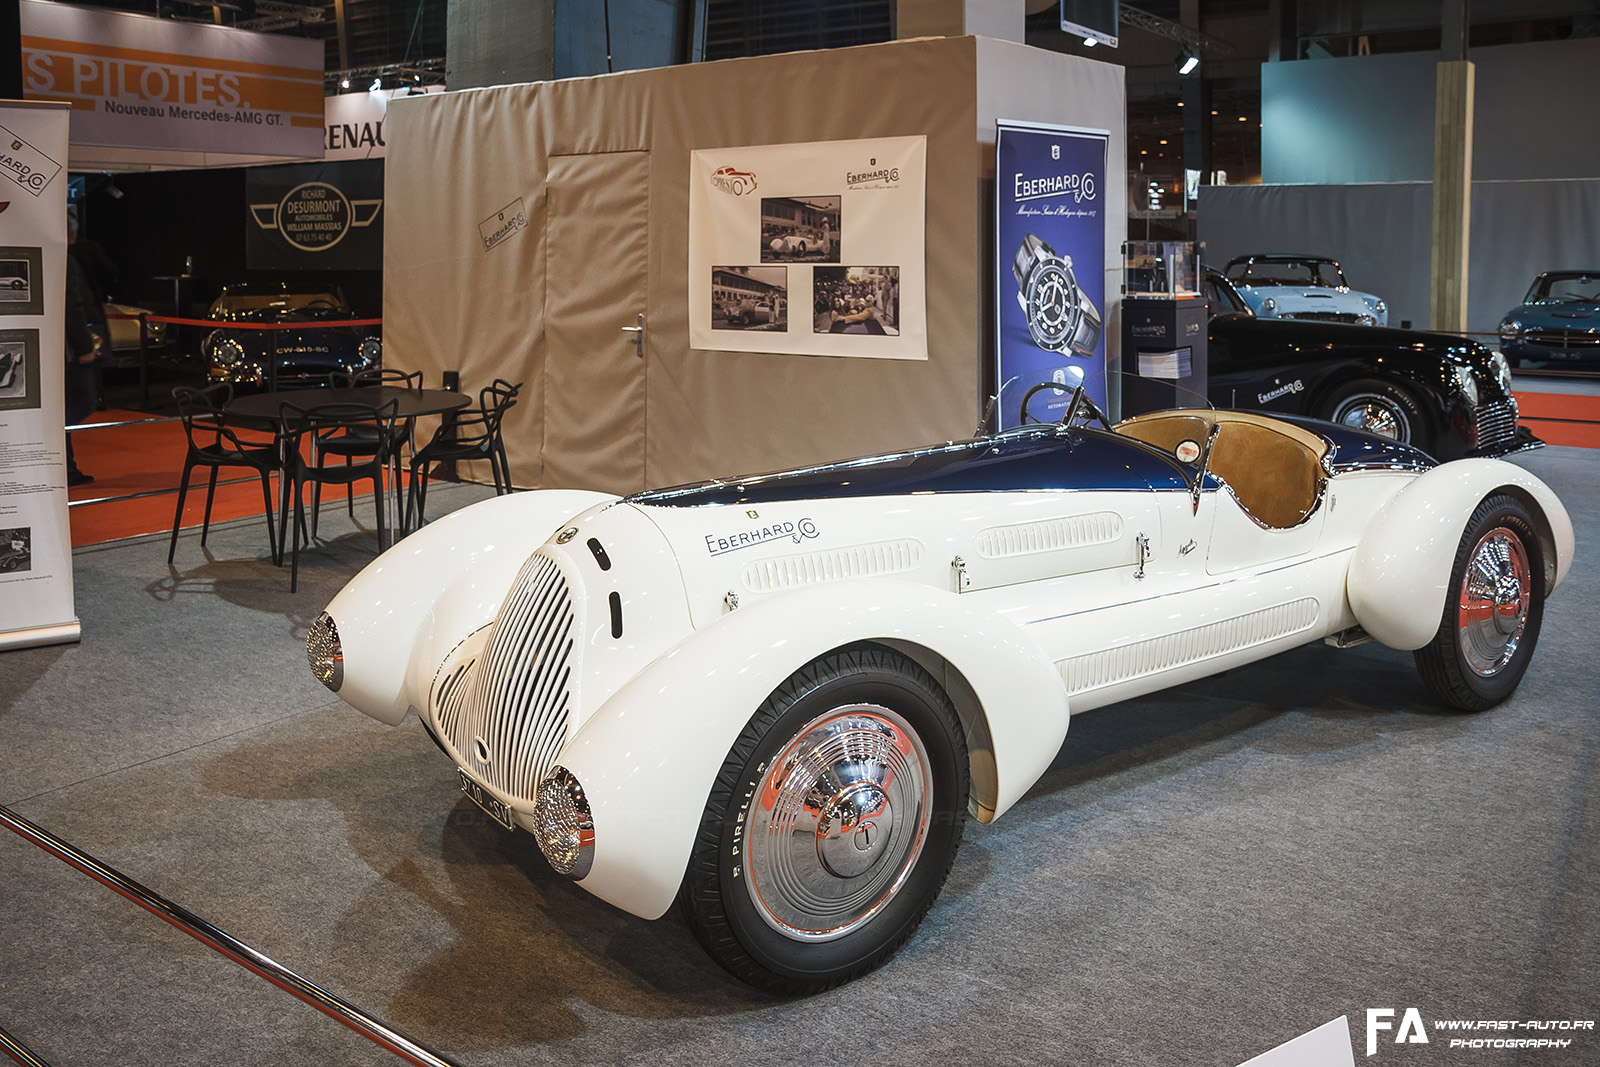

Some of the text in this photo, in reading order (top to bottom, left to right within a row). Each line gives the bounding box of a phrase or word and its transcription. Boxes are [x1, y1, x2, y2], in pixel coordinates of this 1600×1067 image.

[27, 50, 251, 109] S PILOTES.
[105, 100, 284, 126] Nouveau Mercedes-AMG GT.
[846, 170, 888, 184] EBERHARD
[1014, 172, 1080, 198] EBERHARD
[301, 189, 327, 200] RICHARD
[287, 200, 341, 214] DESURMONT
[294, 213, 333, 222] AUTOMOBILES
[286, 222, 342, 232] WILLIAM MASSIAS
[483, 217, 516, 250] EBERHARD
[1257, 383, 1293, 404] EBERHARD
[704, 522, 794, 553] EBERHARD
[732, 781, 756, 856] PIRELLI
